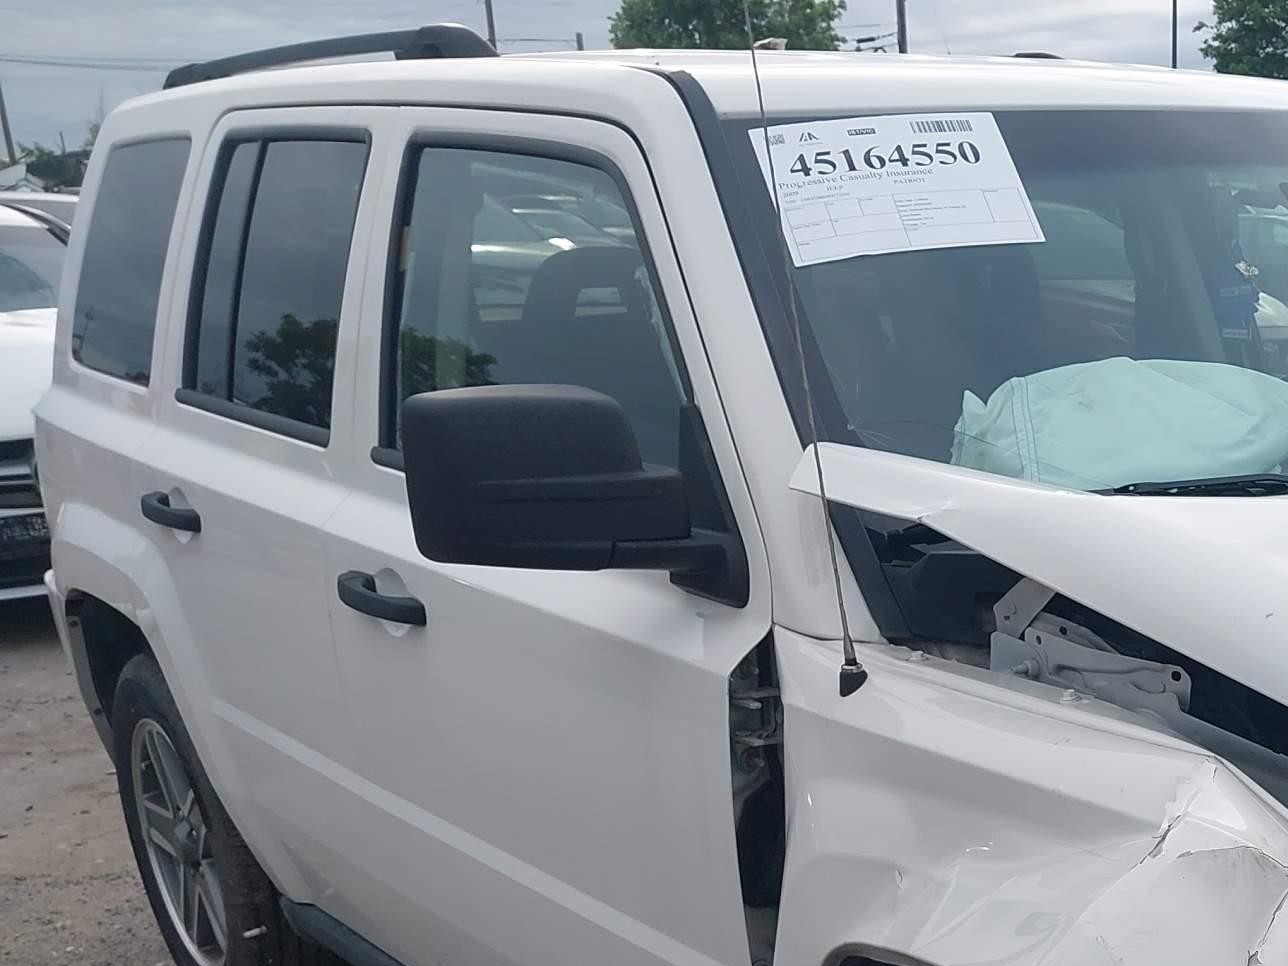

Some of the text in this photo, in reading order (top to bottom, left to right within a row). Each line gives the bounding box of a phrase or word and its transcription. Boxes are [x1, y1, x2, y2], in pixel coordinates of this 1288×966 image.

[790, 140, 980, 177] 45164550
[778, 168, 934, 190] Progressive Casualty Insurance
